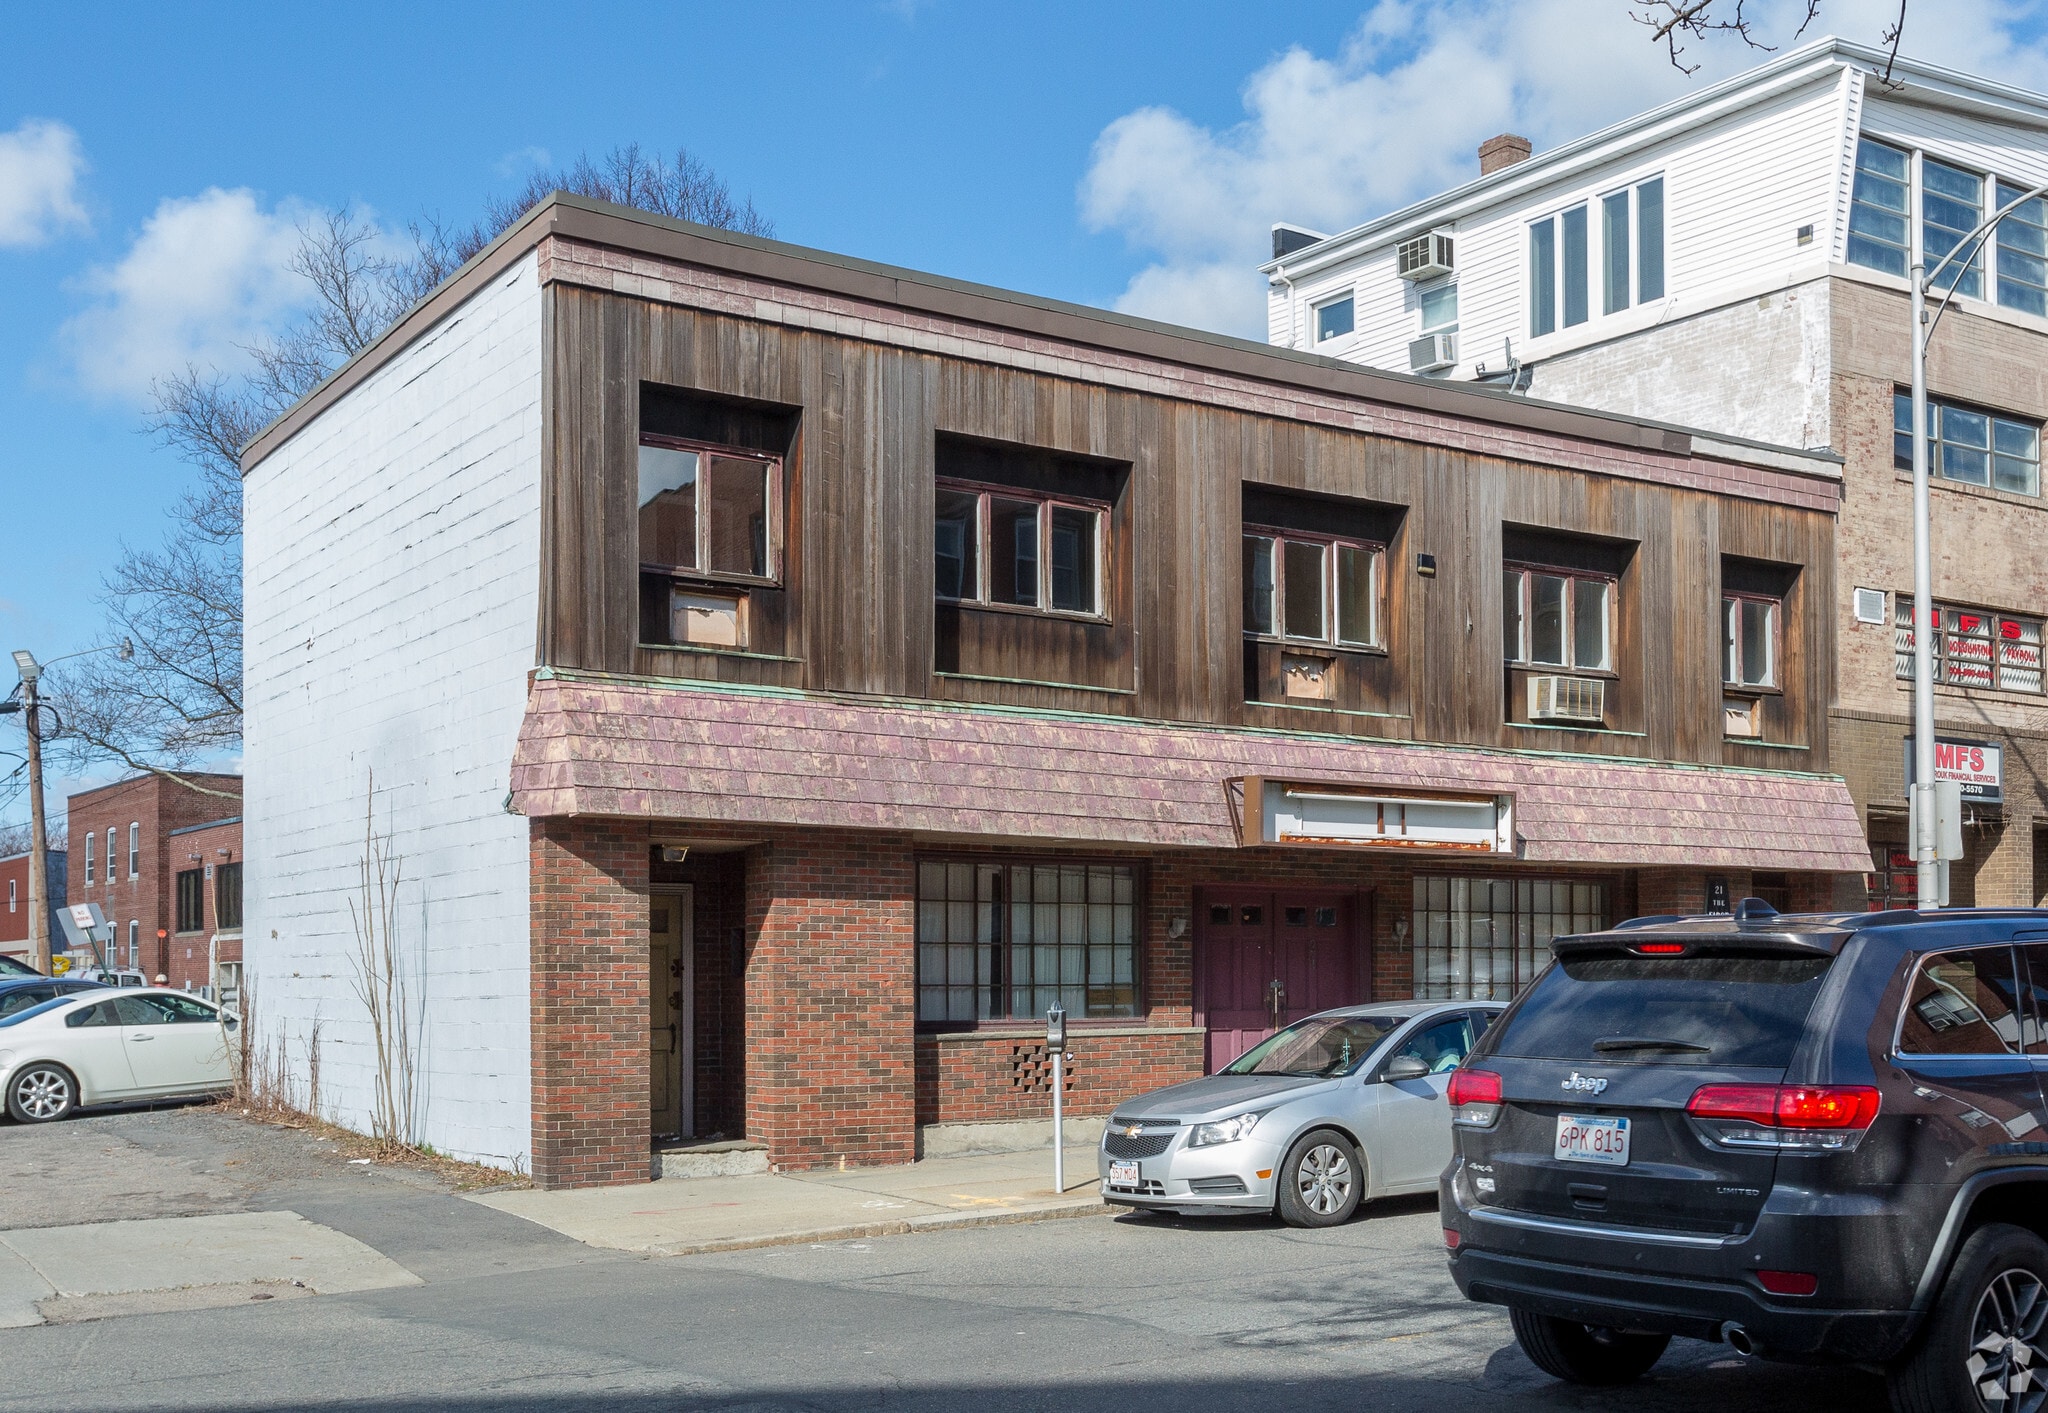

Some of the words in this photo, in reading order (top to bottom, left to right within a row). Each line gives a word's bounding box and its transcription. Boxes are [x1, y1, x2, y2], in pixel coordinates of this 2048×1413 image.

[1949, 640, 1993, 657] ACCOUNTING
[2006, 648, 2037, 662] PAYROLL
[1935, 743, 1985, 772] MFS
[1949, 772, 1973, 782] FINANCIAL
[1973, 773, 1996, 784] SERVICES
[1960, 784, 1983, 794] 0-5570
[1714, 885, 1723, 895] 21
[1561, 1071, 1608, 1097] Jeep
[1560, 1126, 1590, 1151] 6PK
[1594, 1128, 1625, 1153] 815
[1716, 1187, 1760, 1196] LIMITED
